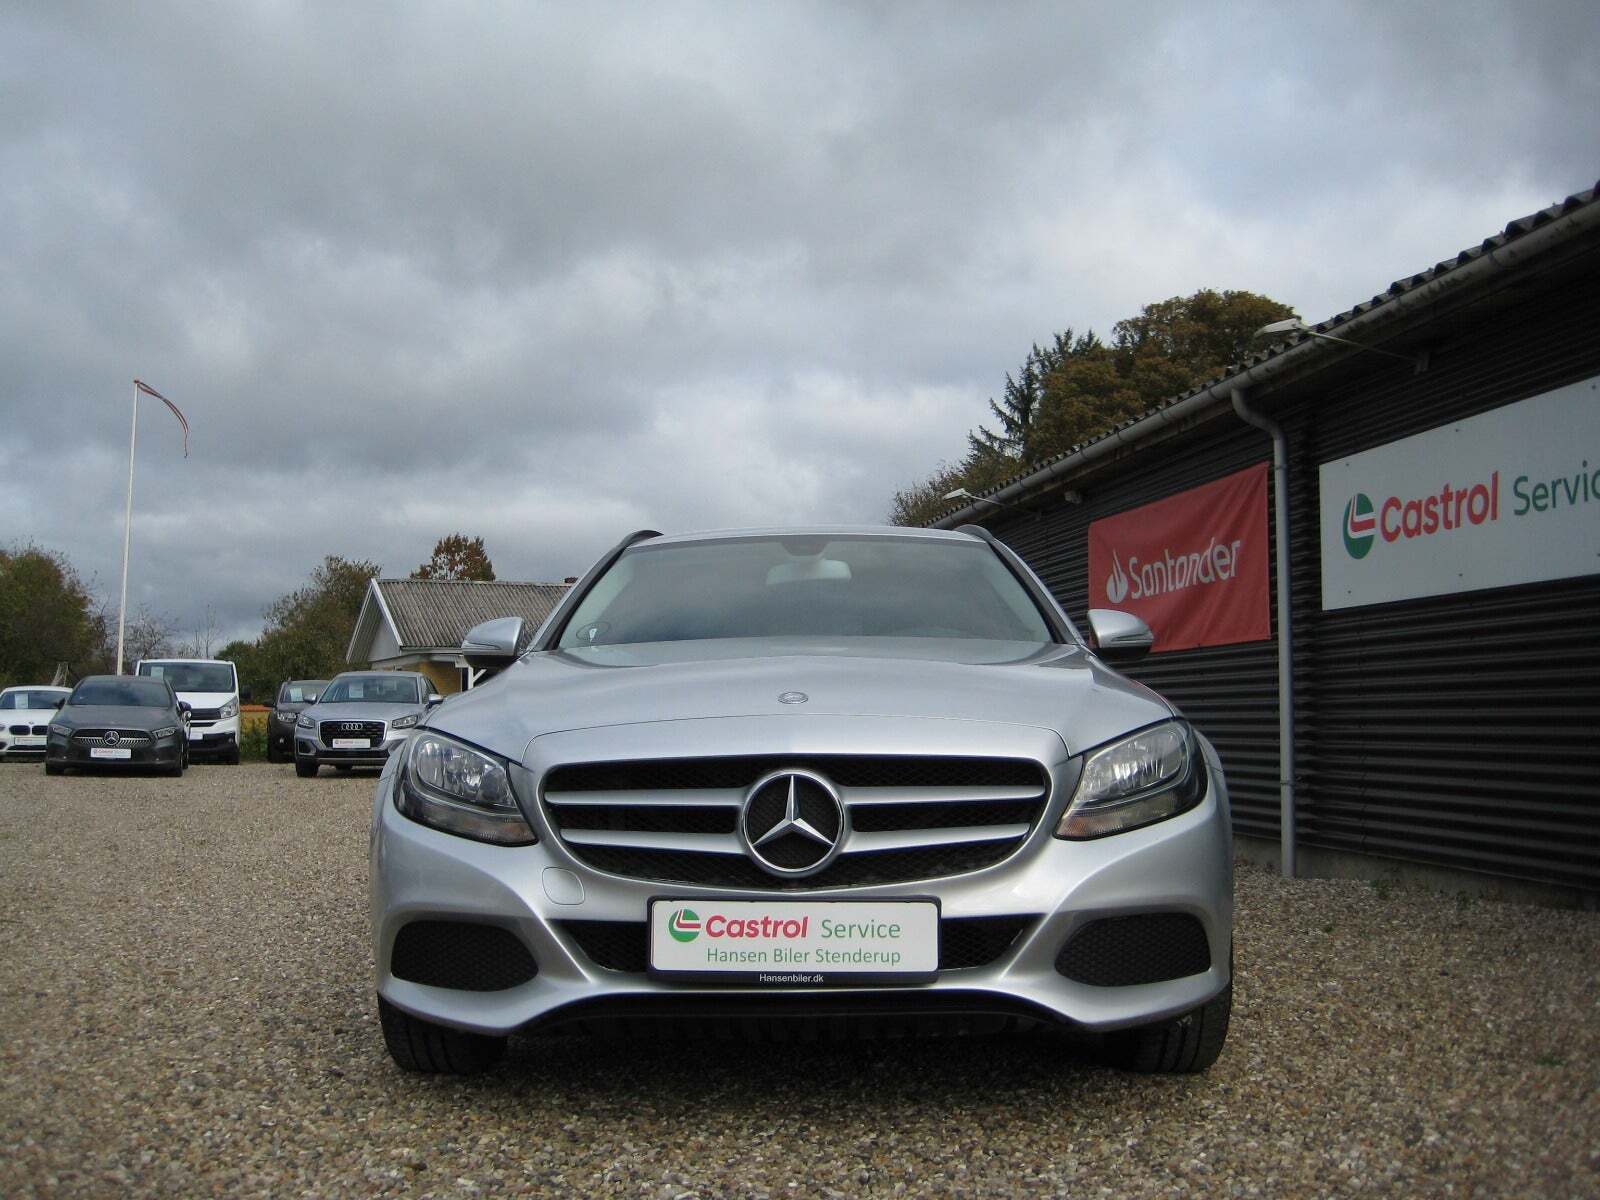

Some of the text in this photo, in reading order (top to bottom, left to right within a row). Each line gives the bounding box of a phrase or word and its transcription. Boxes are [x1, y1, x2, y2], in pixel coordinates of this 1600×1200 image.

[1380, 471, 1499, 543] Castrol
[1128, 537, 1241, 599] Santander
[706, 915, 901, 938] Castrol Service
[707, 948, 901, 967] Hansen Biler Stenderup
[759, 974, 824, 983] Hansenbiler.dk
